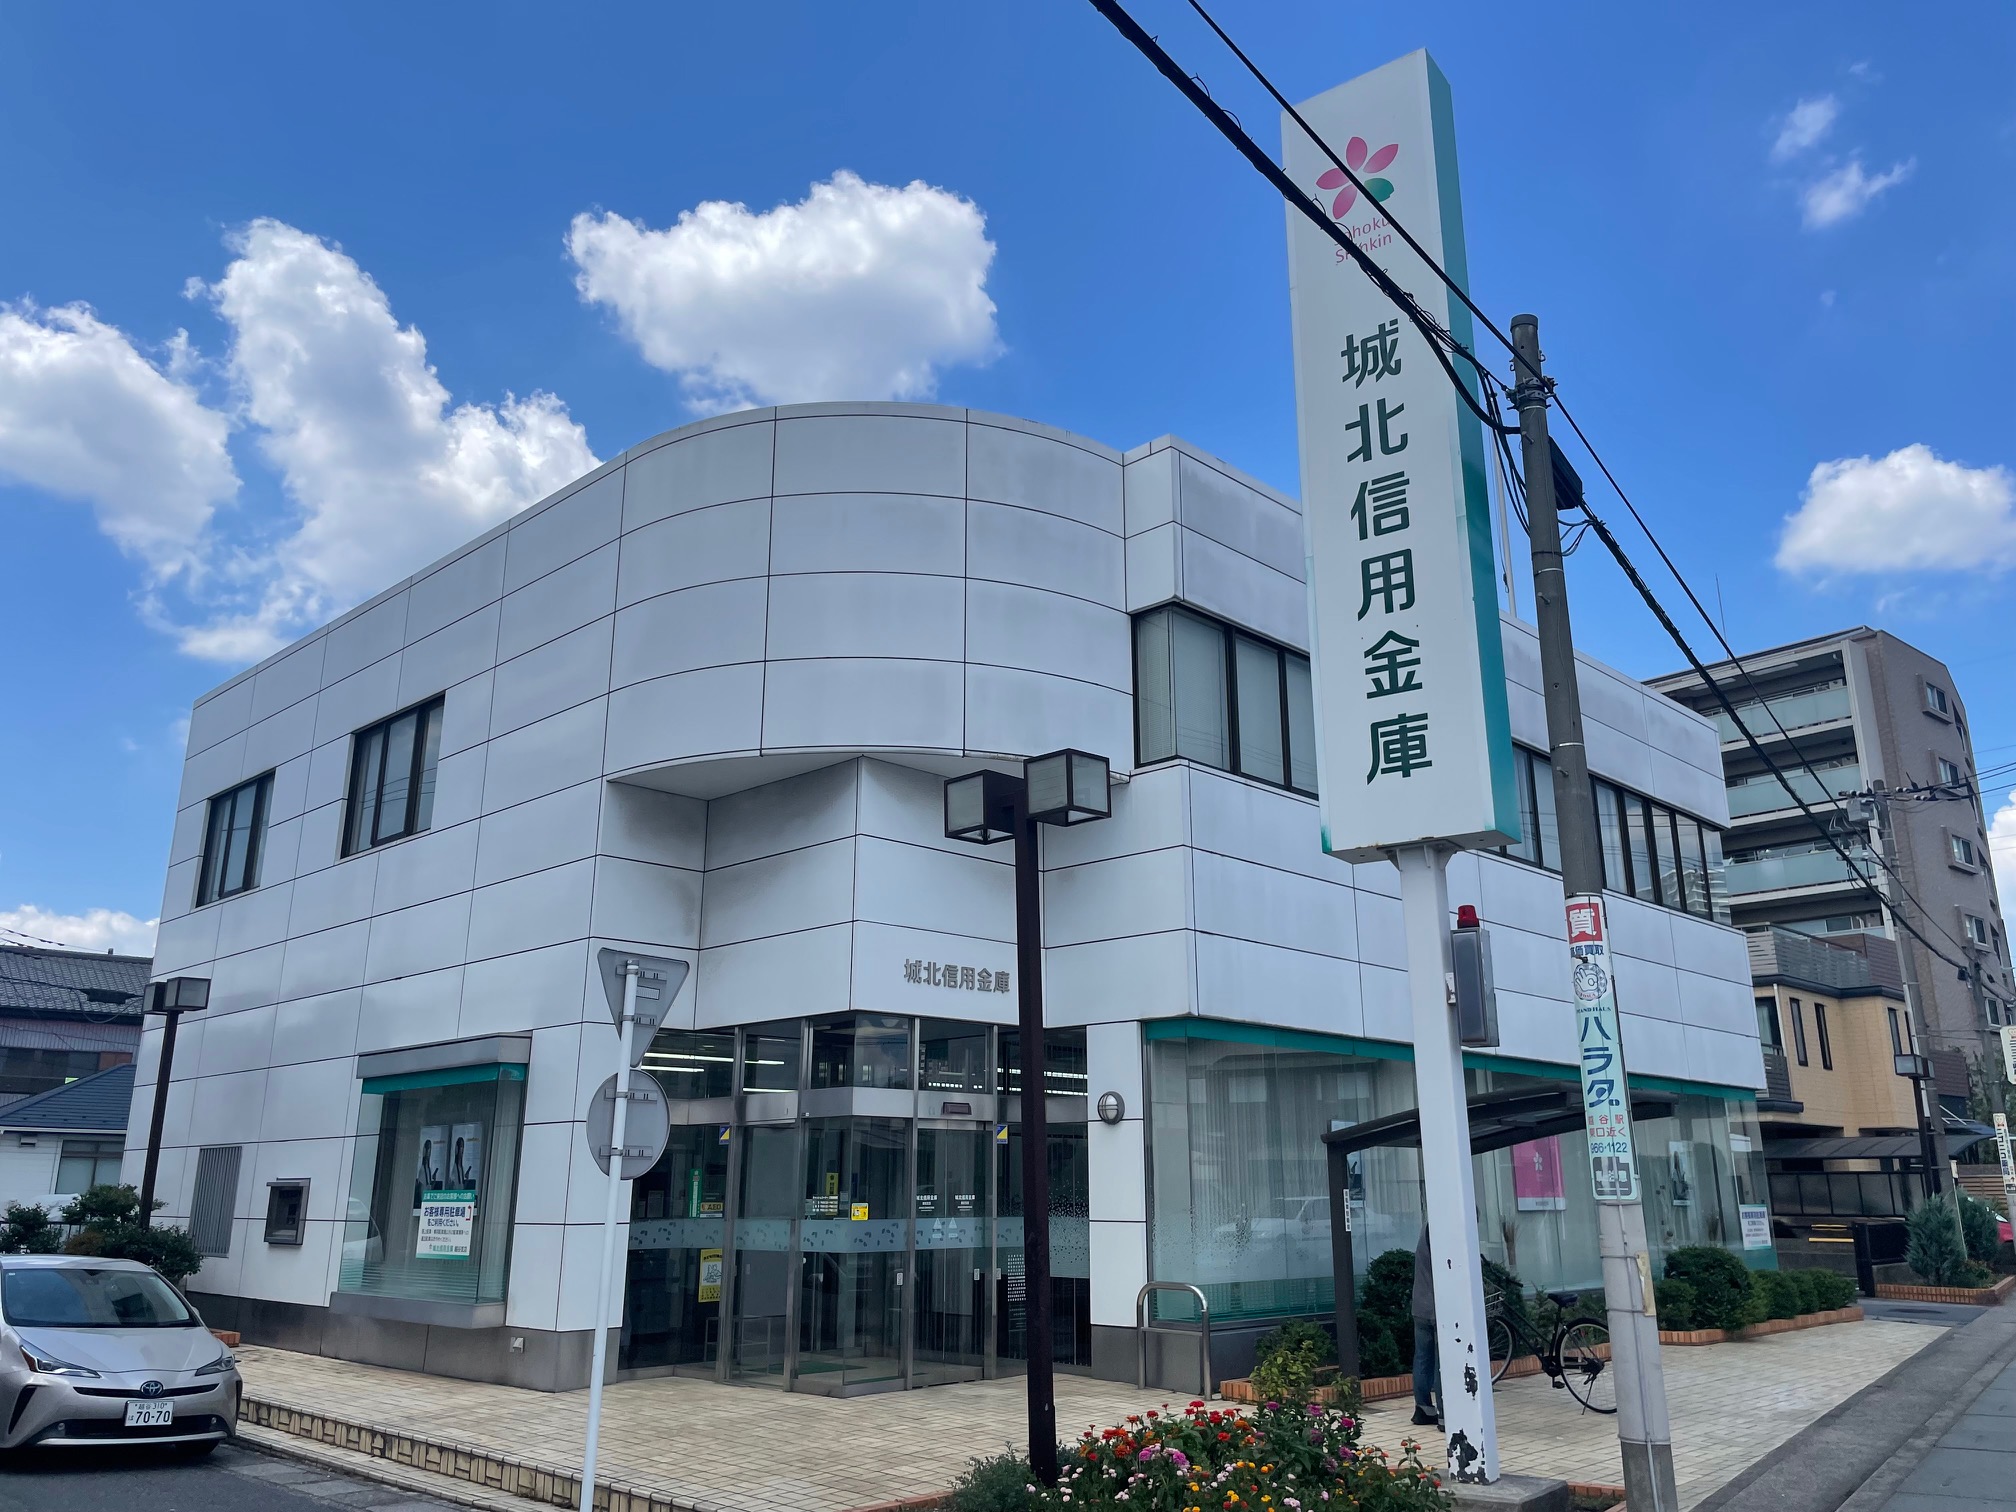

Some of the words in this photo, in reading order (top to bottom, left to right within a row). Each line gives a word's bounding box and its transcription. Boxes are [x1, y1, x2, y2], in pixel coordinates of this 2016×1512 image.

[1335, 217, 1391, 246] hoku
[1335, 233, 1392, 264] Snkin
[1341, 318, 1433, 786] 城北信用金庫
[1568, 908, 1598, 938] 質
[903, 958, 1010, 994] 城北信用金庫
[1580, 1016, 1620, 1108] ハラダ
[135, 1410, 171, 1424] 70-70
